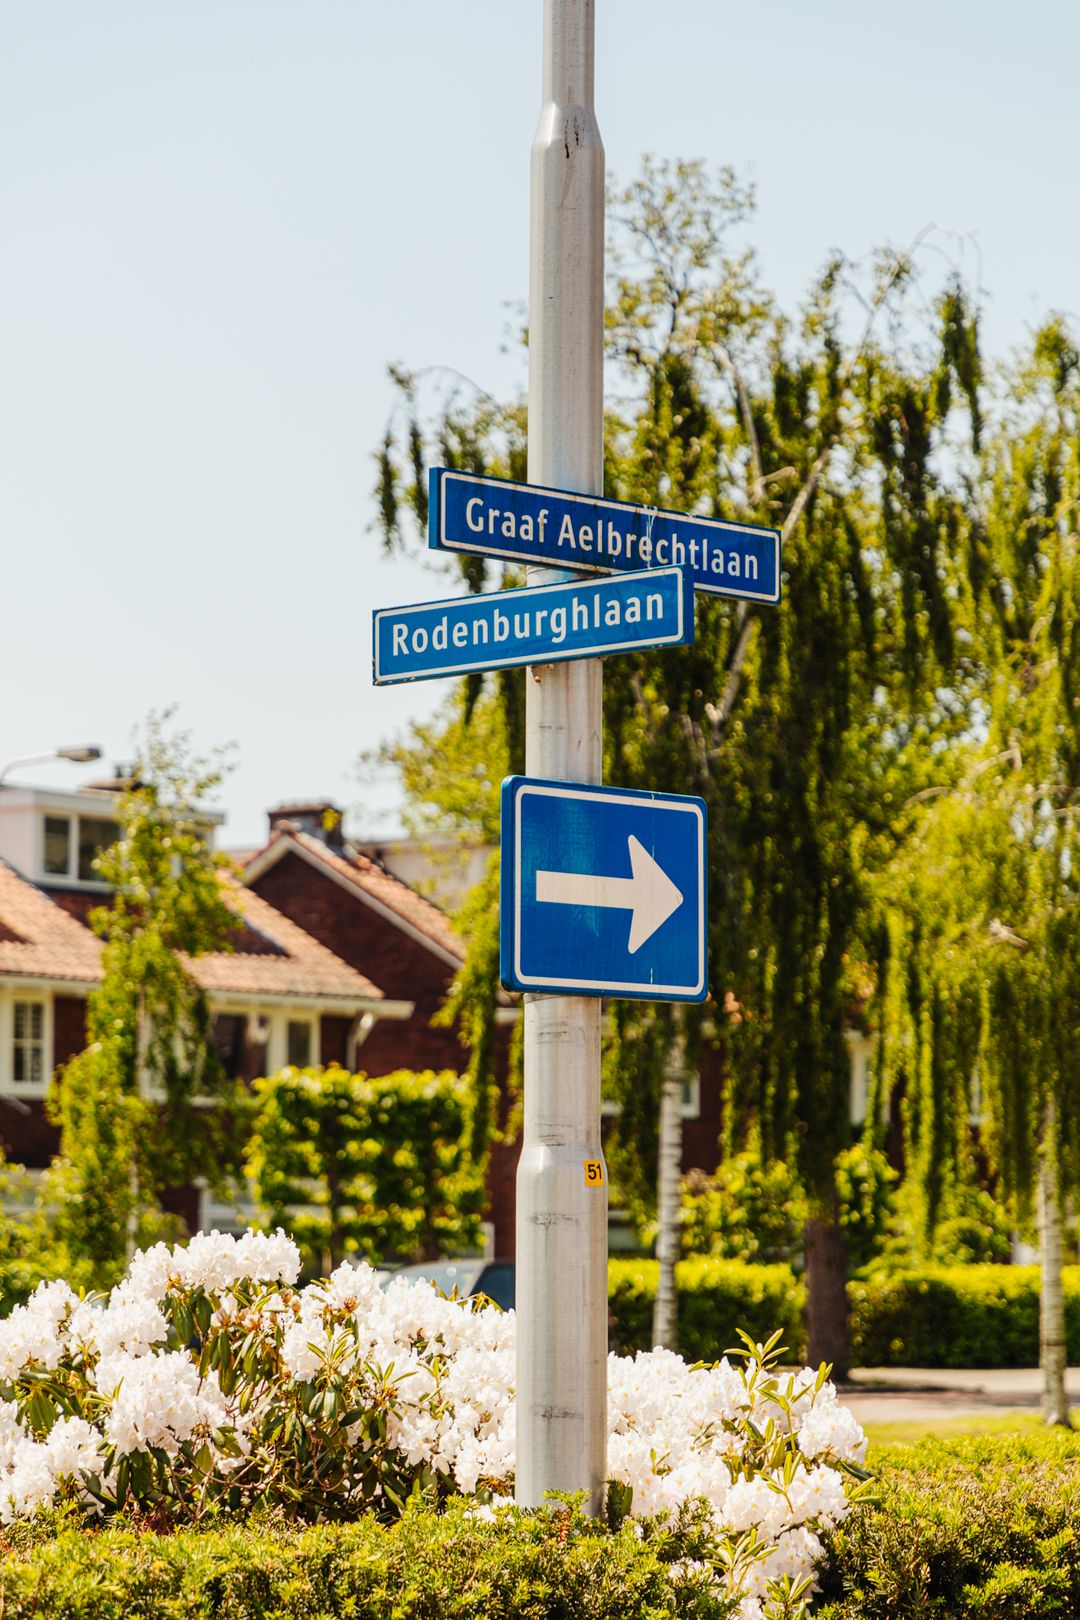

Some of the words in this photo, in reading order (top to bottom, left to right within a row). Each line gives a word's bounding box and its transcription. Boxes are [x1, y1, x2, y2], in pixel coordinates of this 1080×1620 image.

[466, 497, 548, 543] Graaf
[558, 514, 759, 580] Aelbrechtlaan
[392, 592, 664, 656] Rodenburghlaan
[588, 1164, 602, 1180] 51
